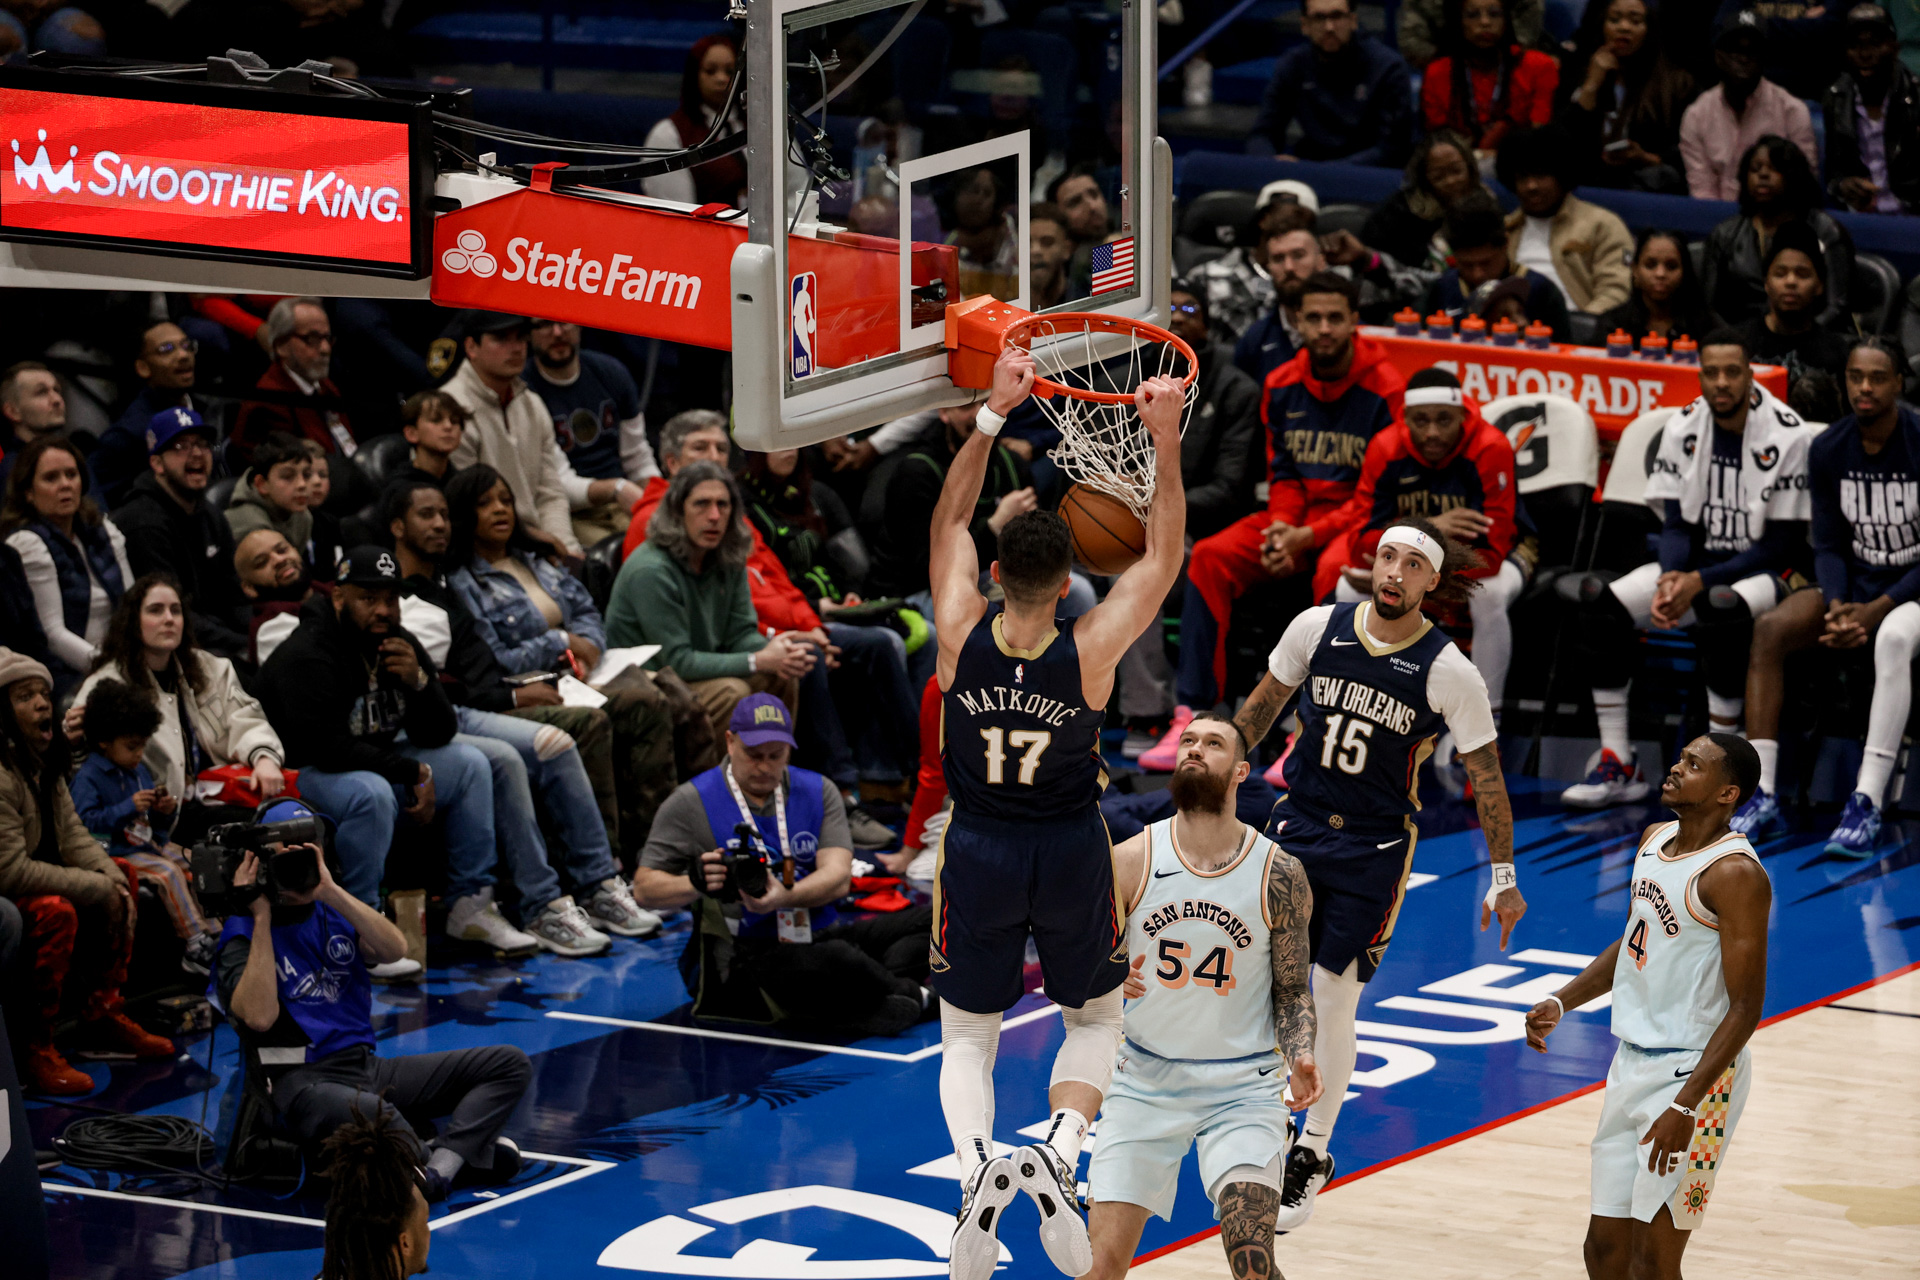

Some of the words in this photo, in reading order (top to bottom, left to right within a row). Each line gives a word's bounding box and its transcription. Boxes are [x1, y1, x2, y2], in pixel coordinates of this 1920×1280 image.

[88, 150, 293, 213] SMOOTHIE
[795, 355, 808, 374] NBA
[1840, 479, 1920, 525] BLACK
[1389, 656, 1421, 672] NEWAGE
[754, 704, 786, 726] NOLA
[956, 685, 1082, 728] MATKOVIĆ
[1311, 675, 1345, 707] NEW
[1341, 681, 1416, 736] ORLEANS
[980, 726, 1052, 787] 17
[1320, 713, 1374, 776] 15
[1142, 902, 1181, 941] SAN
[1181, 898, 1255, 951] ANTONIO
[1637, 877, 1682, 938] ANTONIO
[1155, 937, 1237, 997] 54
[1627, 916, 1649, 972] 4
